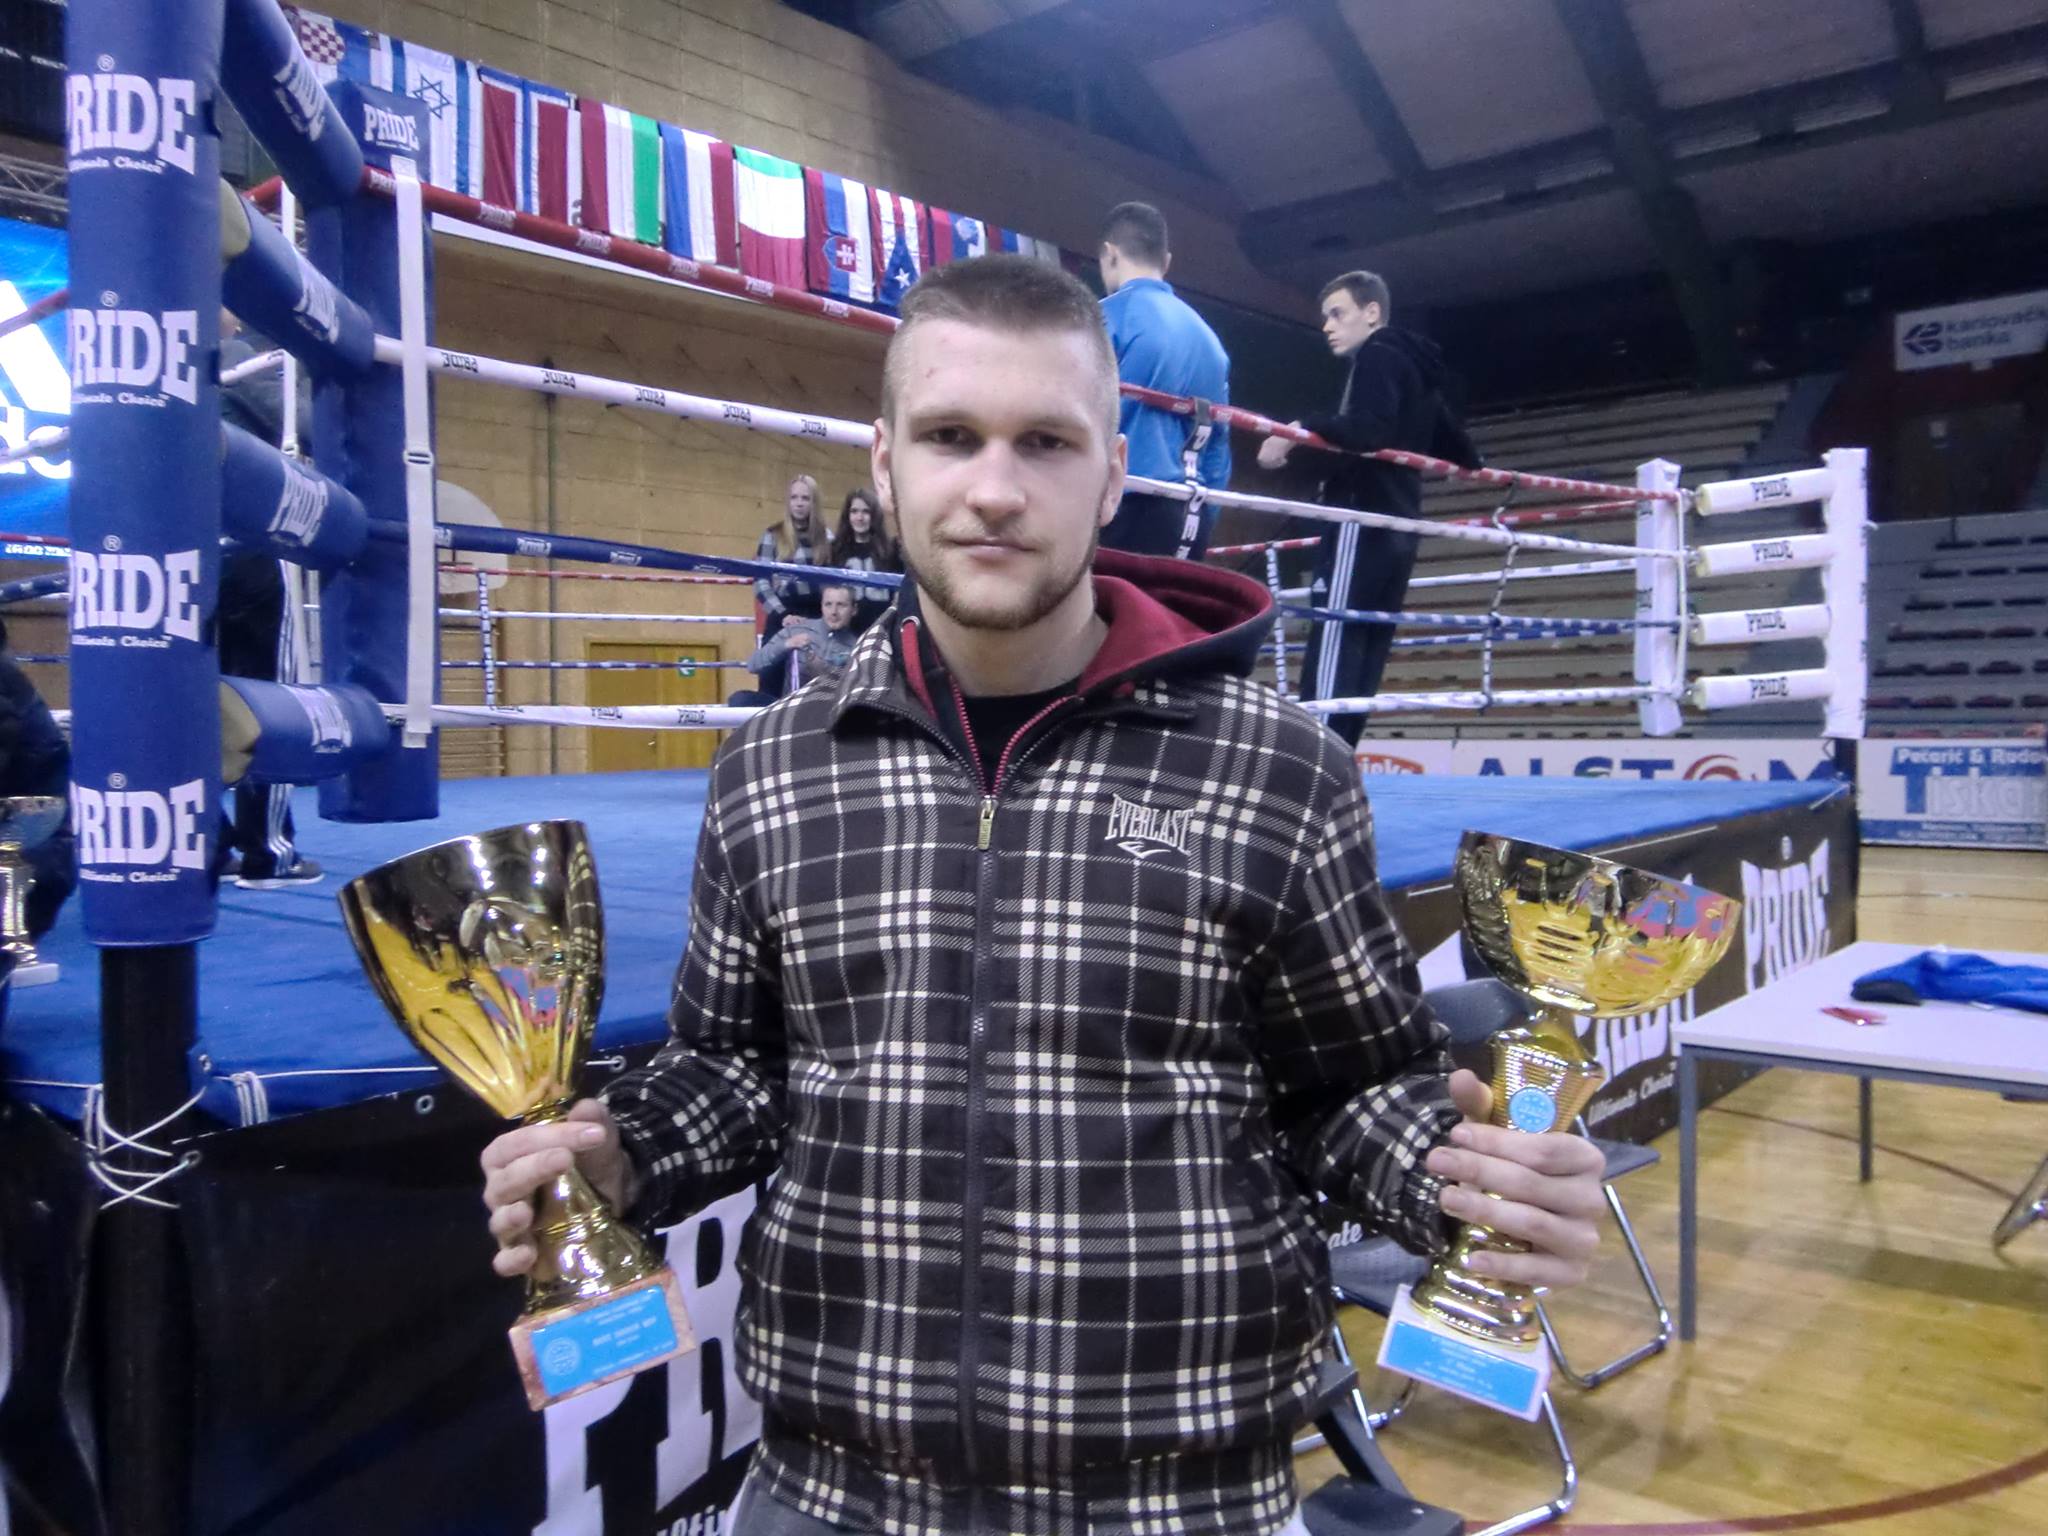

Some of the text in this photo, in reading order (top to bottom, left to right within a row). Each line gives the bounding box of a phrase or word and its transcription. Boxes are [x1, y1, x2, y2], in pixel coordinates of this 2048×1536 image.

[65, 73, 196, 176] RIDE
[363, 103, 420, 151] PRIDE
[69, 308, 198, 405] RIDE
[1751, 478, 1792, 501] PRIDE
[1752, 541, 1793, 562] PRIDE
[70, 549, 200, 642] RIDE
[1746, 611, 1786, 633] PRIDE
[1749, 676, 1789, 699] PRIDE
[1104, 793, 1195, 856] EVERLAST
